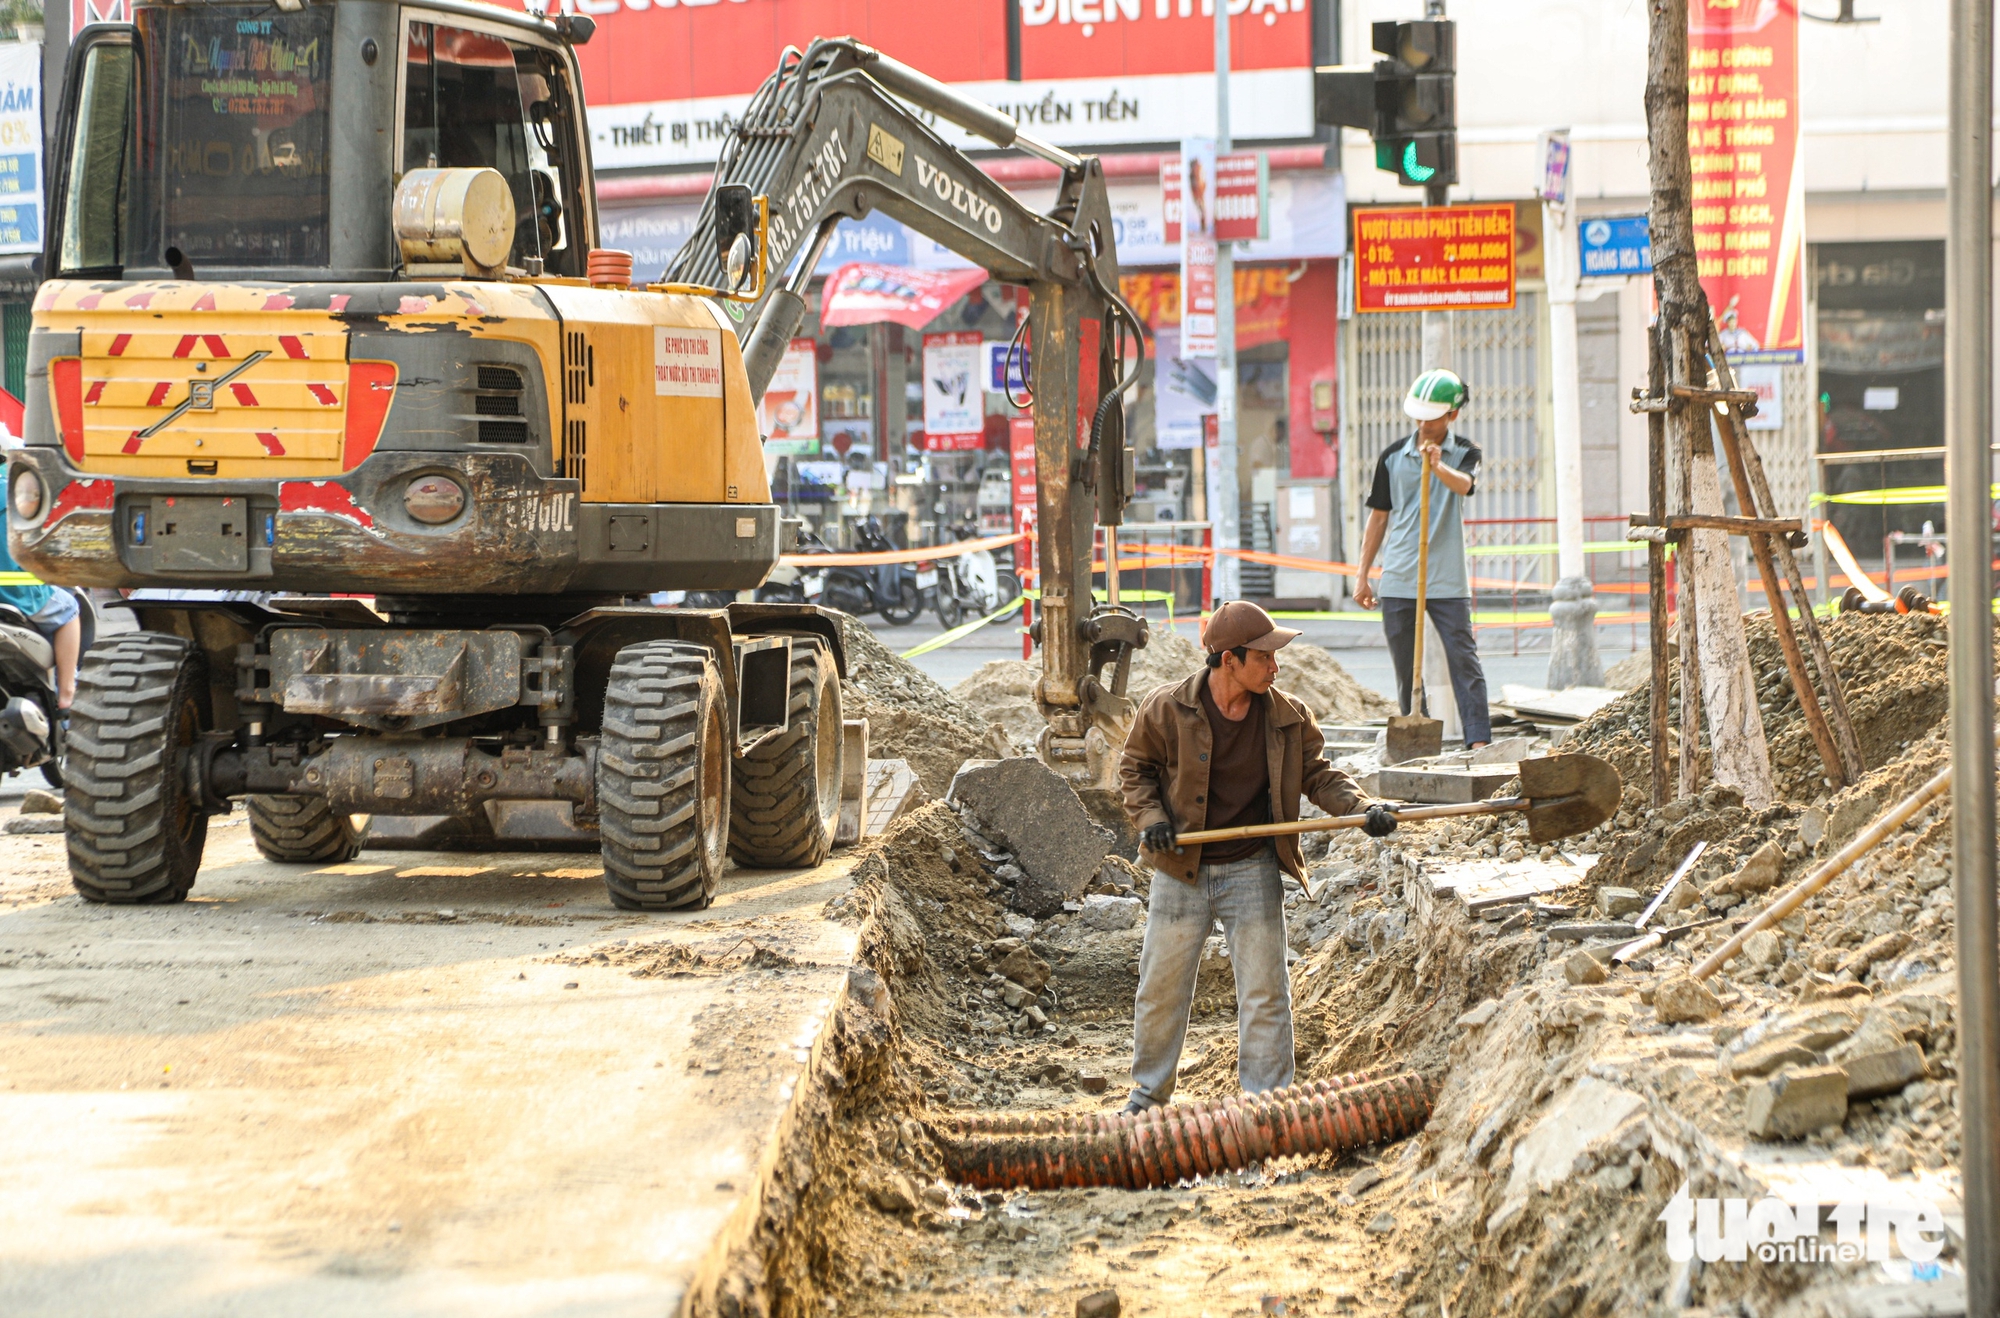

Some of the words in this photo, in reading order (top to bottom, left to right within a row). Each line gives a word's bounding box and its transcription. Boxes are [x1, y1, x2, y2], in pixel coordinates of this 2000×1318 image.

[261, 20, 272, 34] TY
[1688, 46, 1719, 69] ĂNG
[611, 111, 663, 147] THIẾT
[672, 122, 688, 147] BỊ
[695, 111, 737, 141] THÔ
[1688, 125, 1701, 148] À
[1725, 121, 1774, 146] THỐNG
[1737, 152, 1762, 176] TRỊ
[914, 155, 1002, 234] VOLVO
[1692, 177, 1733, 200] HÀNH
[1735, 173, 1767, 198] PHỐ
[636, 216, 678, 237] Phone
[1361, 220, 1389, 243] VƯỢT
[1389, 217, 1412, 239] ĐÈN
[1413, 212, 1428, 239] ĐỎ
[1429, 217, 1457, 241] PHẠT
[1459, 210, 1483, 237] TIỀN
[843, 226, 894, 257] Triệu
[1585, 246, 1618, 271] HOÀNG
[1369, 266, 1387, 286] MÔ
[1406, 268, 1419, 284] XE
